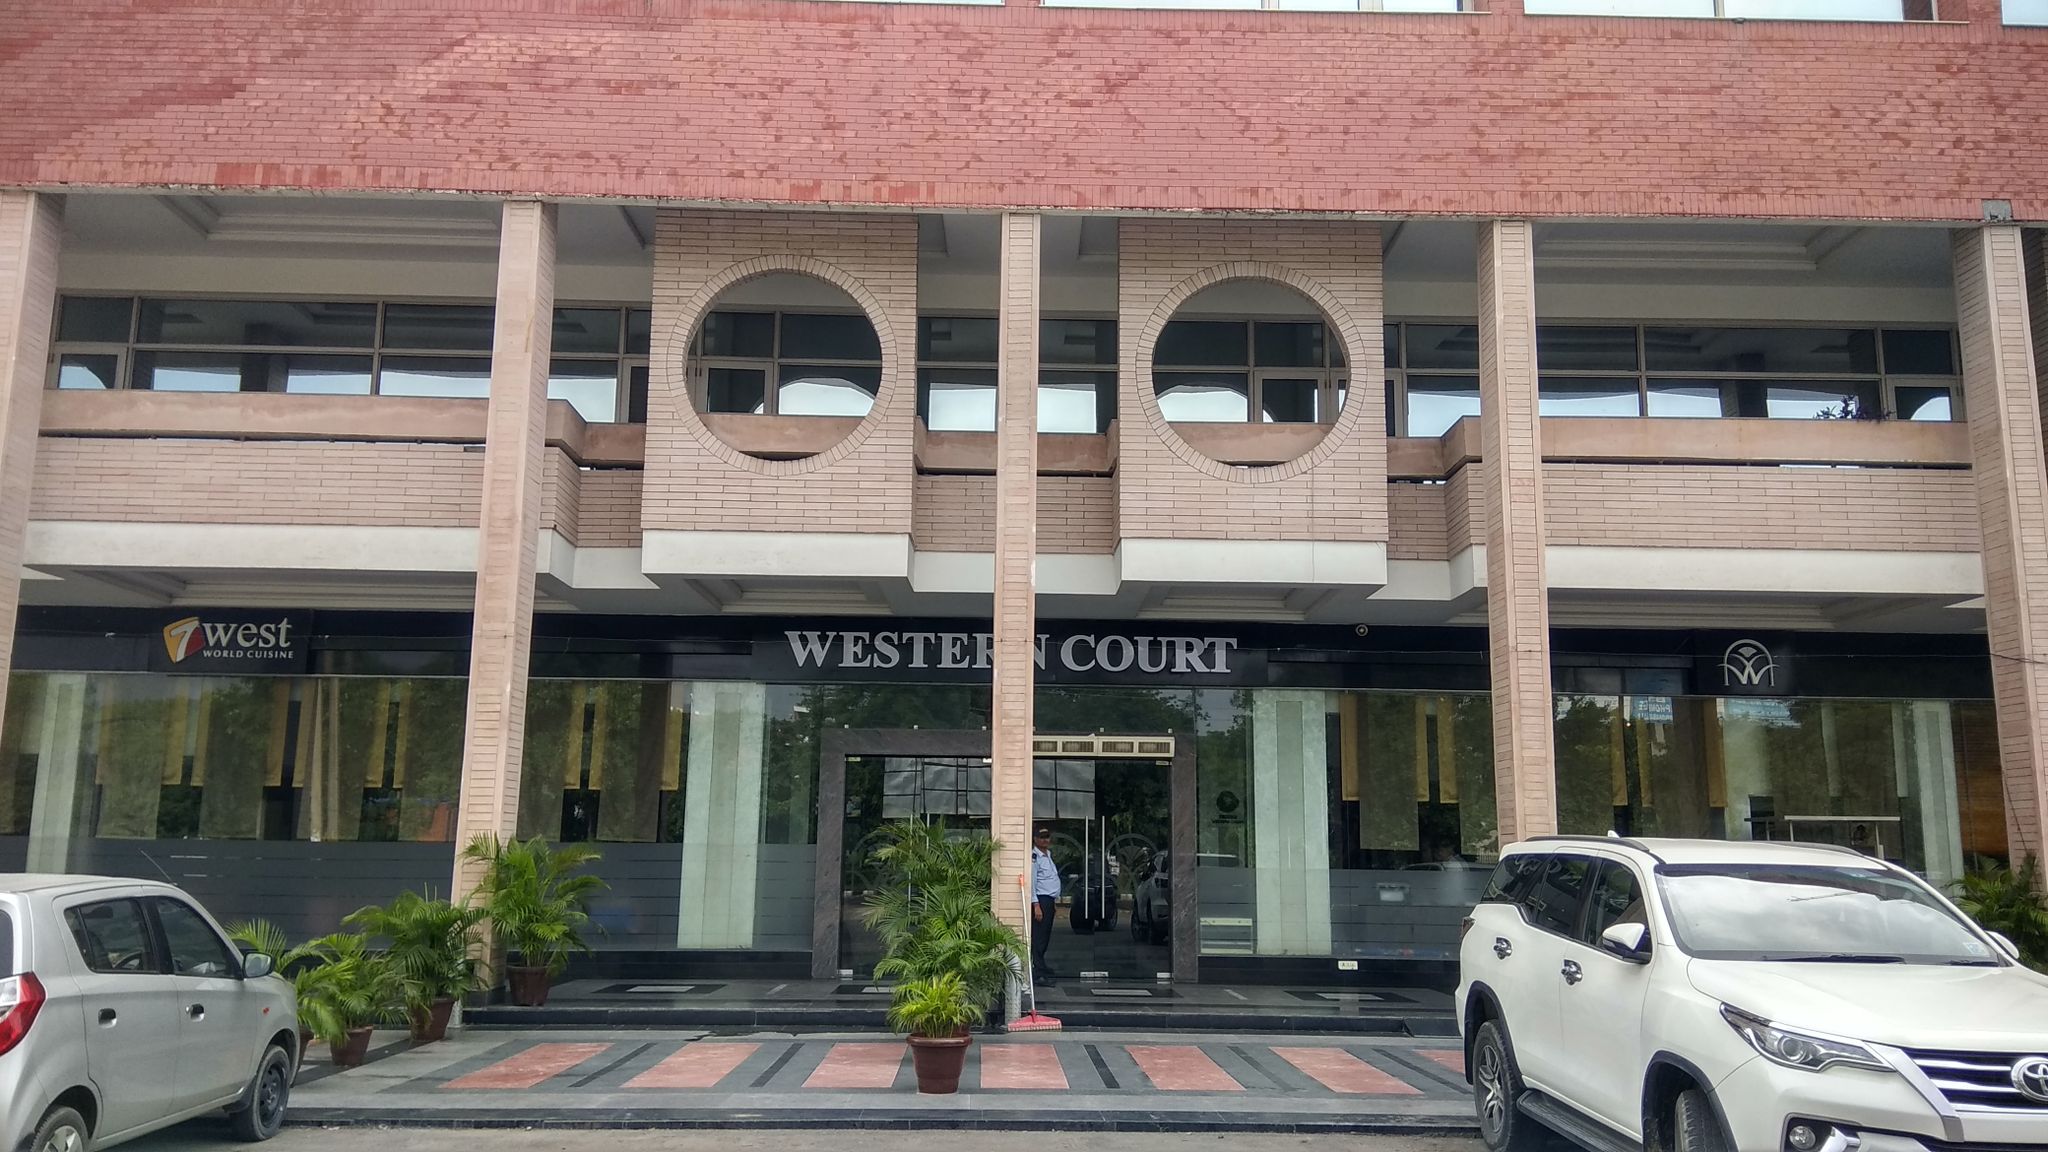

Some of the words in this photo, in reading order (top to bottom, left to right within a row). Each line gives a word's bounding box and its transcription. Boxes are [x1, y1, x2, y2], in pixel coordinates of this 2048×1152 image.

[202, 617, 293, 648] west
[203, 650, 244, 658] WORLD
[247, 651, 294, 659] CUISINE
[1060, 634, 1238, 673] COURT
